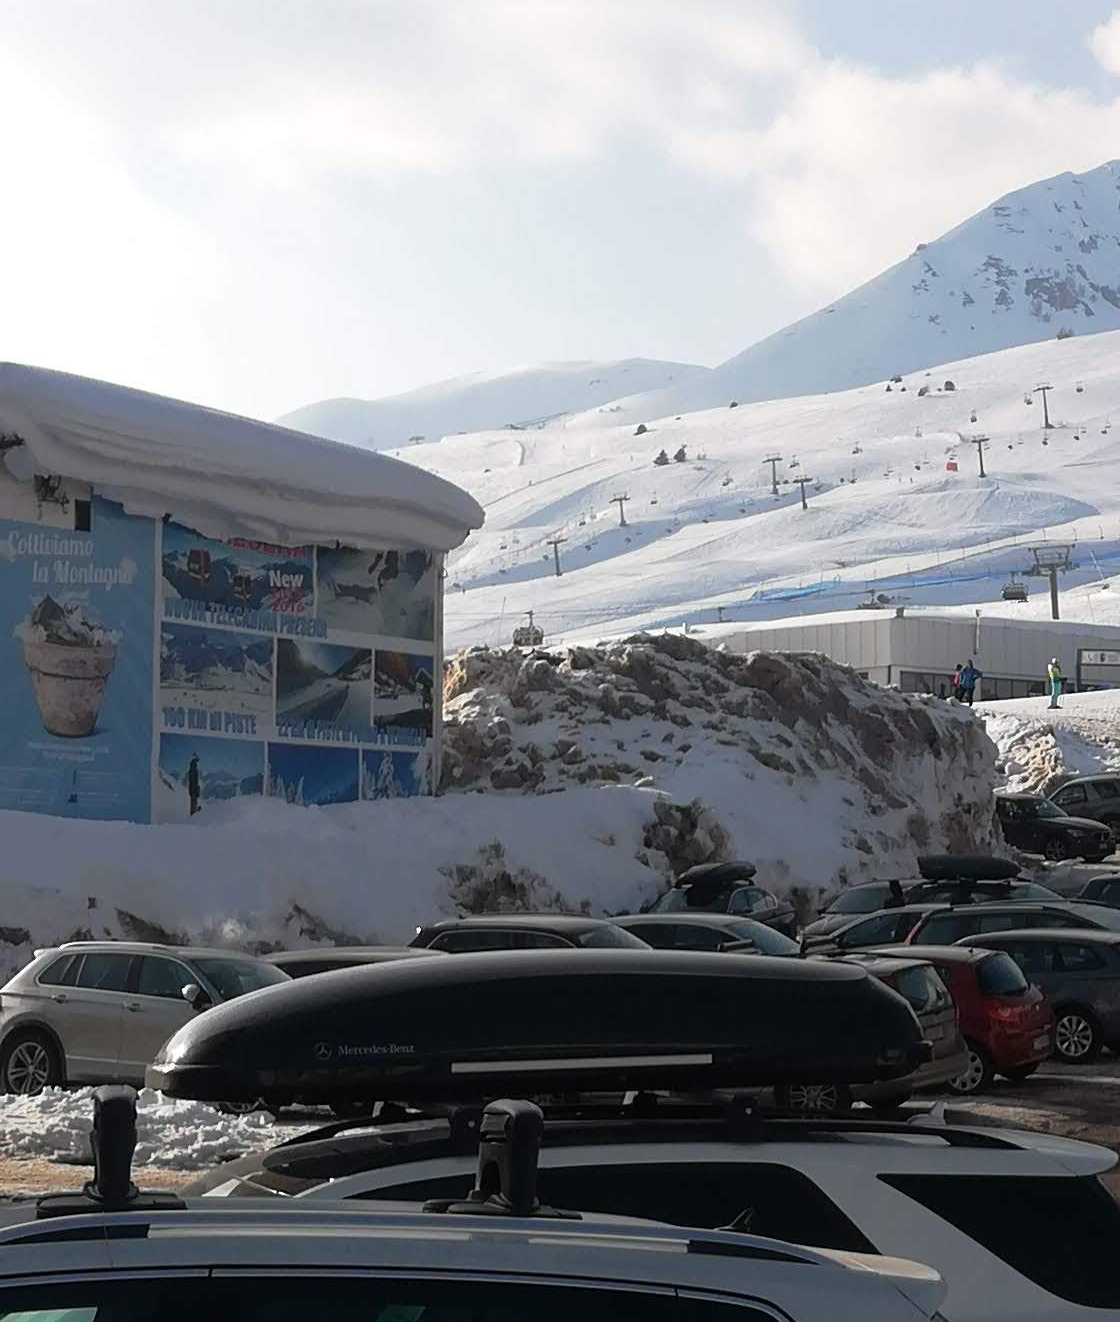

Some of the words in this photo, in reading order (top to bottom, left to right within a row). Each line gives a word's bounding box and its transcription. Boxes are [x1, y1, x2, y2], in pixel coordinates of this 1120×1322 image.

[269, 570, 304, 588] New
[223, 713, 257, 735] PISTE
[338, 1044, 416, 1056] Mercedes-Benz
